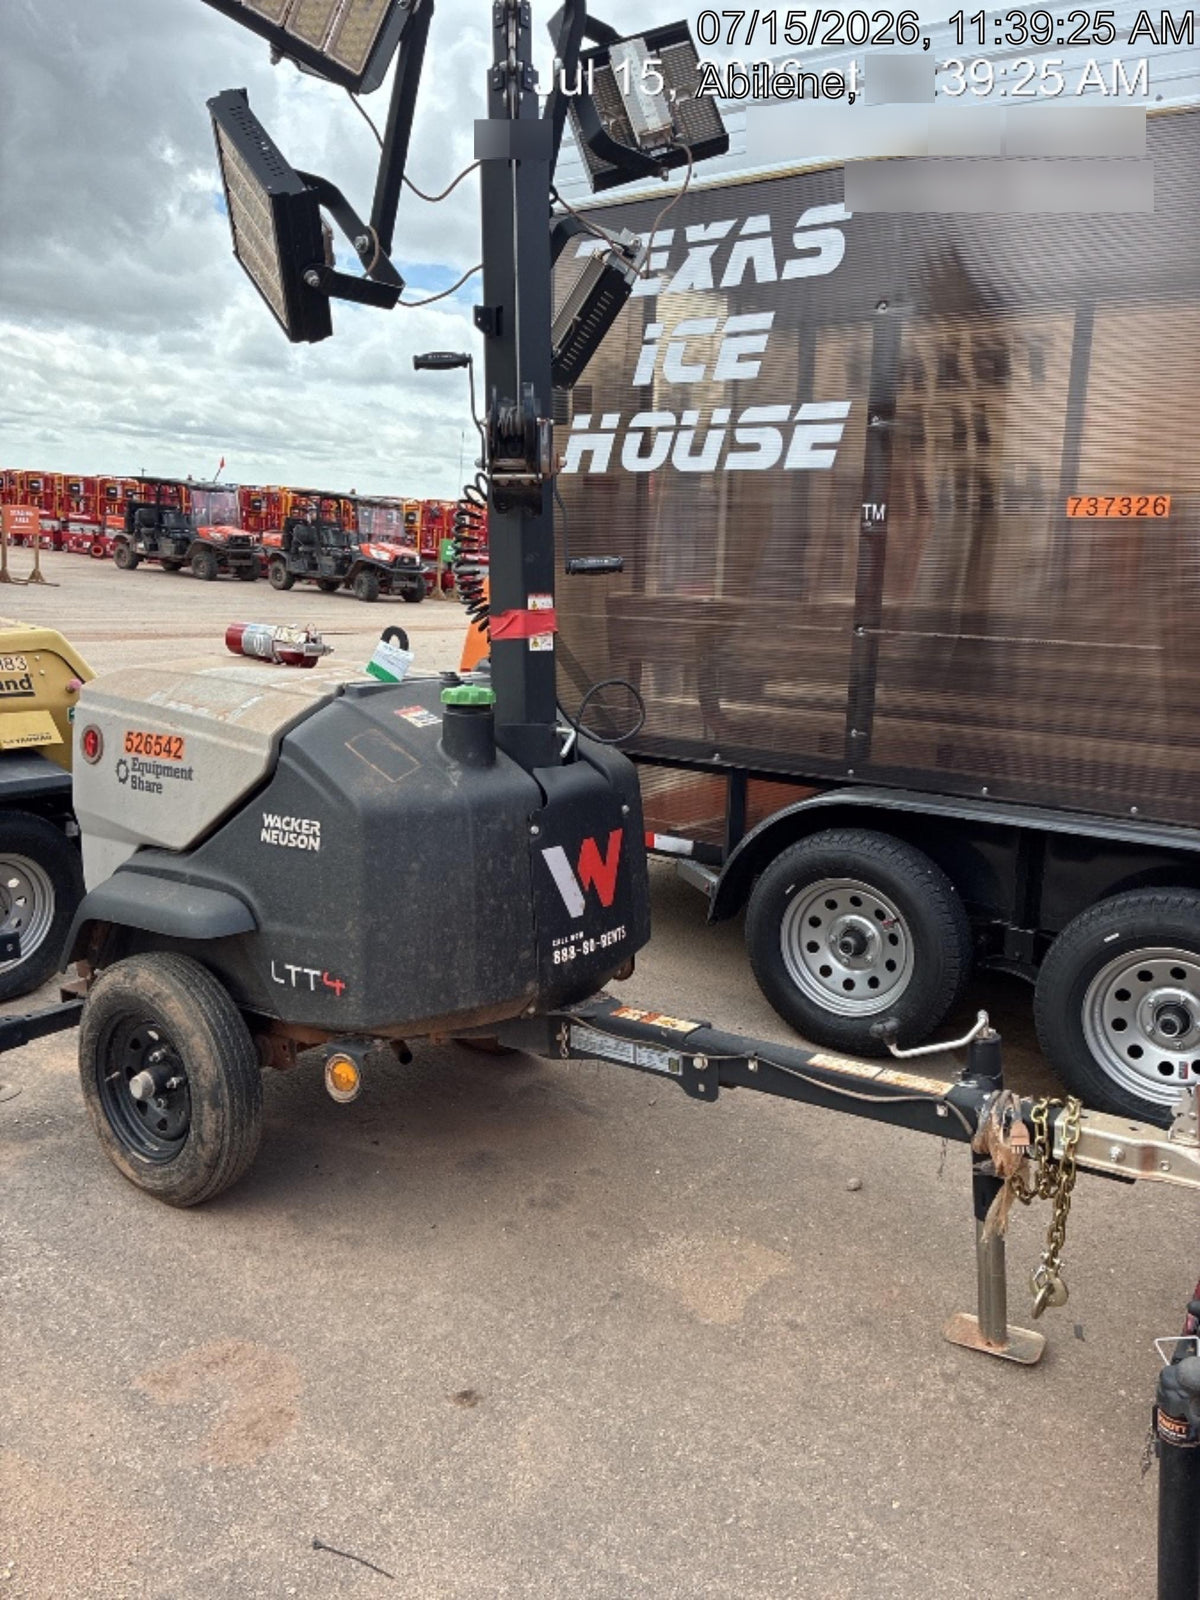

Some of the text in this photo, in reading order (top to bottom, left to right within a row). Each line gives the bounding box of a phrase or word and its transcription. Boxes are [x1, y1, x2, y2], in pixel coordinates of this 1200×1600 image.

[561, 401, 852, 474] HOUSE
[862, 503, 886, 521] TM
[1070, 496, 1167, 517] 737326
[125, 731, 184, 759] 526542
[131, 757, 194, 781] Equipment
[131, 774, 163, 794] Share
[262, 813, 321, 836] WACKER
[260, 828, 321, 852] NEUSON
[271, 960, 346, 997] LTT4
